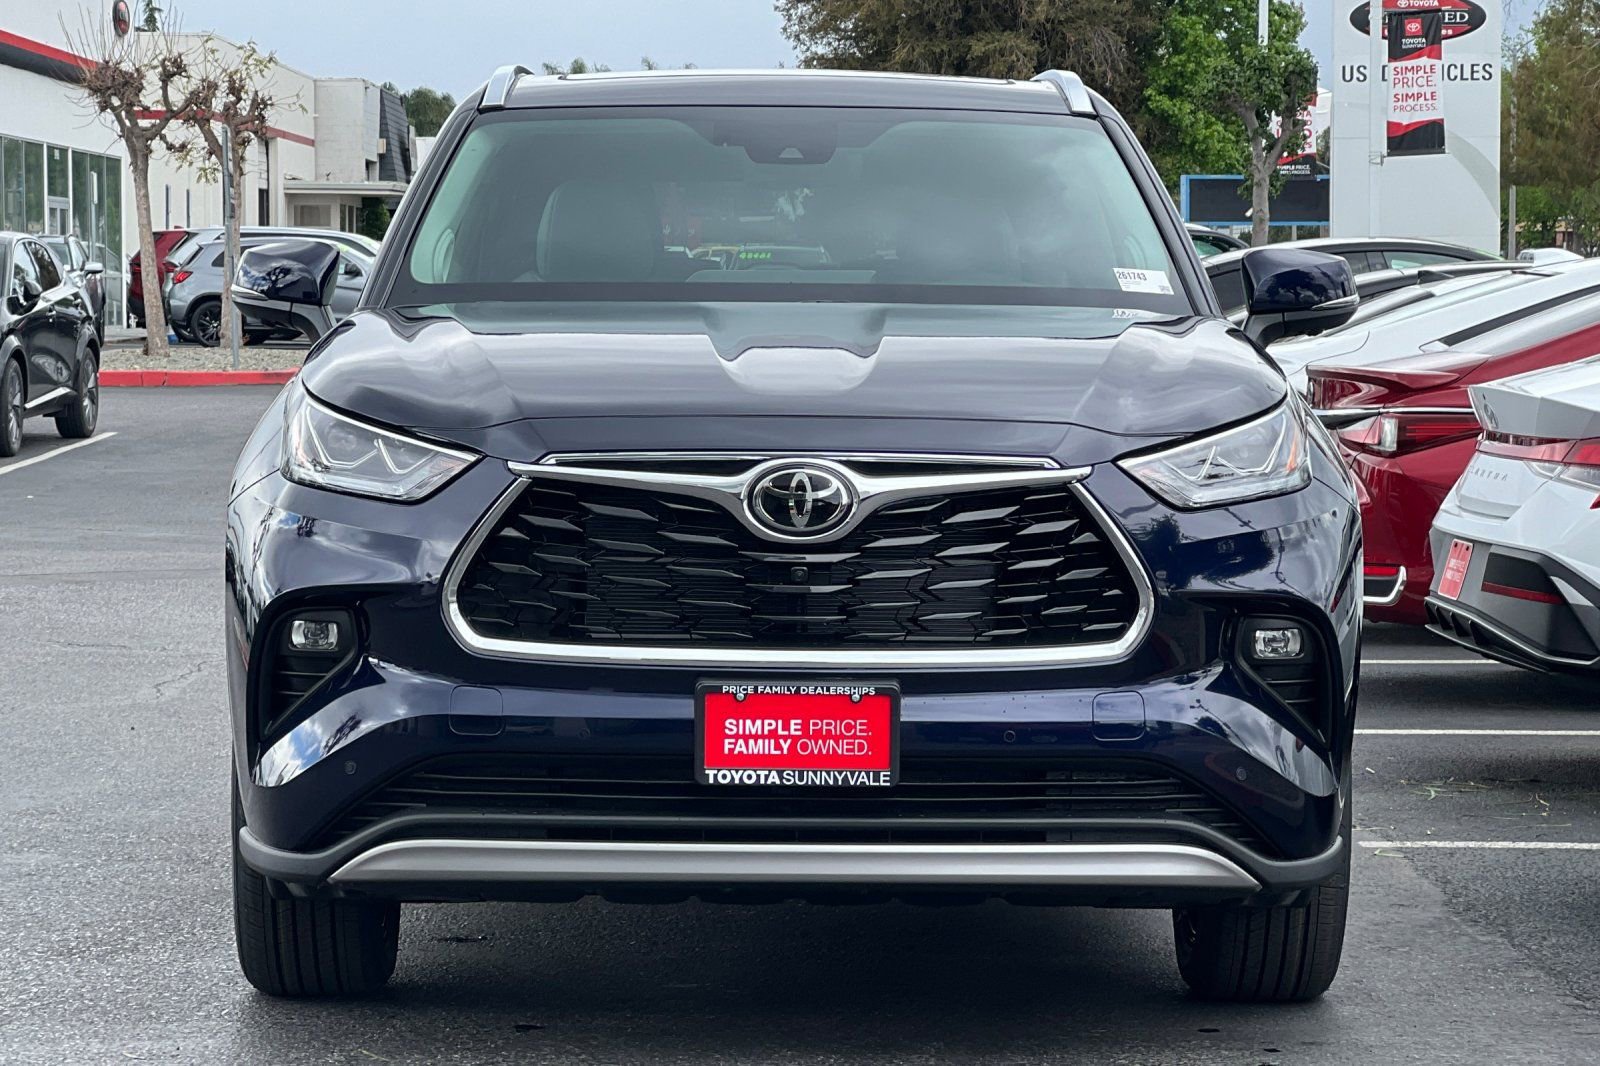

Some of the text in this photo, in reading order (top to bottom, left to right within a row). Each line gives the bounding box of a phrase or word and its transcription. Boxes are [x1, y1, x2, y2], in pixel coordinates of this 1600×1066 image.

[1393, 64, 1437, 76] SIMPLE
[1441, 63, 1493, 81] ICLES
[1393, 75, 1437, 88] PRICE.
[1393, 91, 1437, 103] SIMPLE
[1393, 103, 1438, 113] PROCESS.
[722, 685, 876, 696] PRICE FAMILY DEALERSHIPS
[724, 719, 872, 736] SIMPLE PRICE.
[723, 738, 872, 756] FAMILY OWNED.
[705, 769, 891, 786] TOYOTA SUNNYVALE
